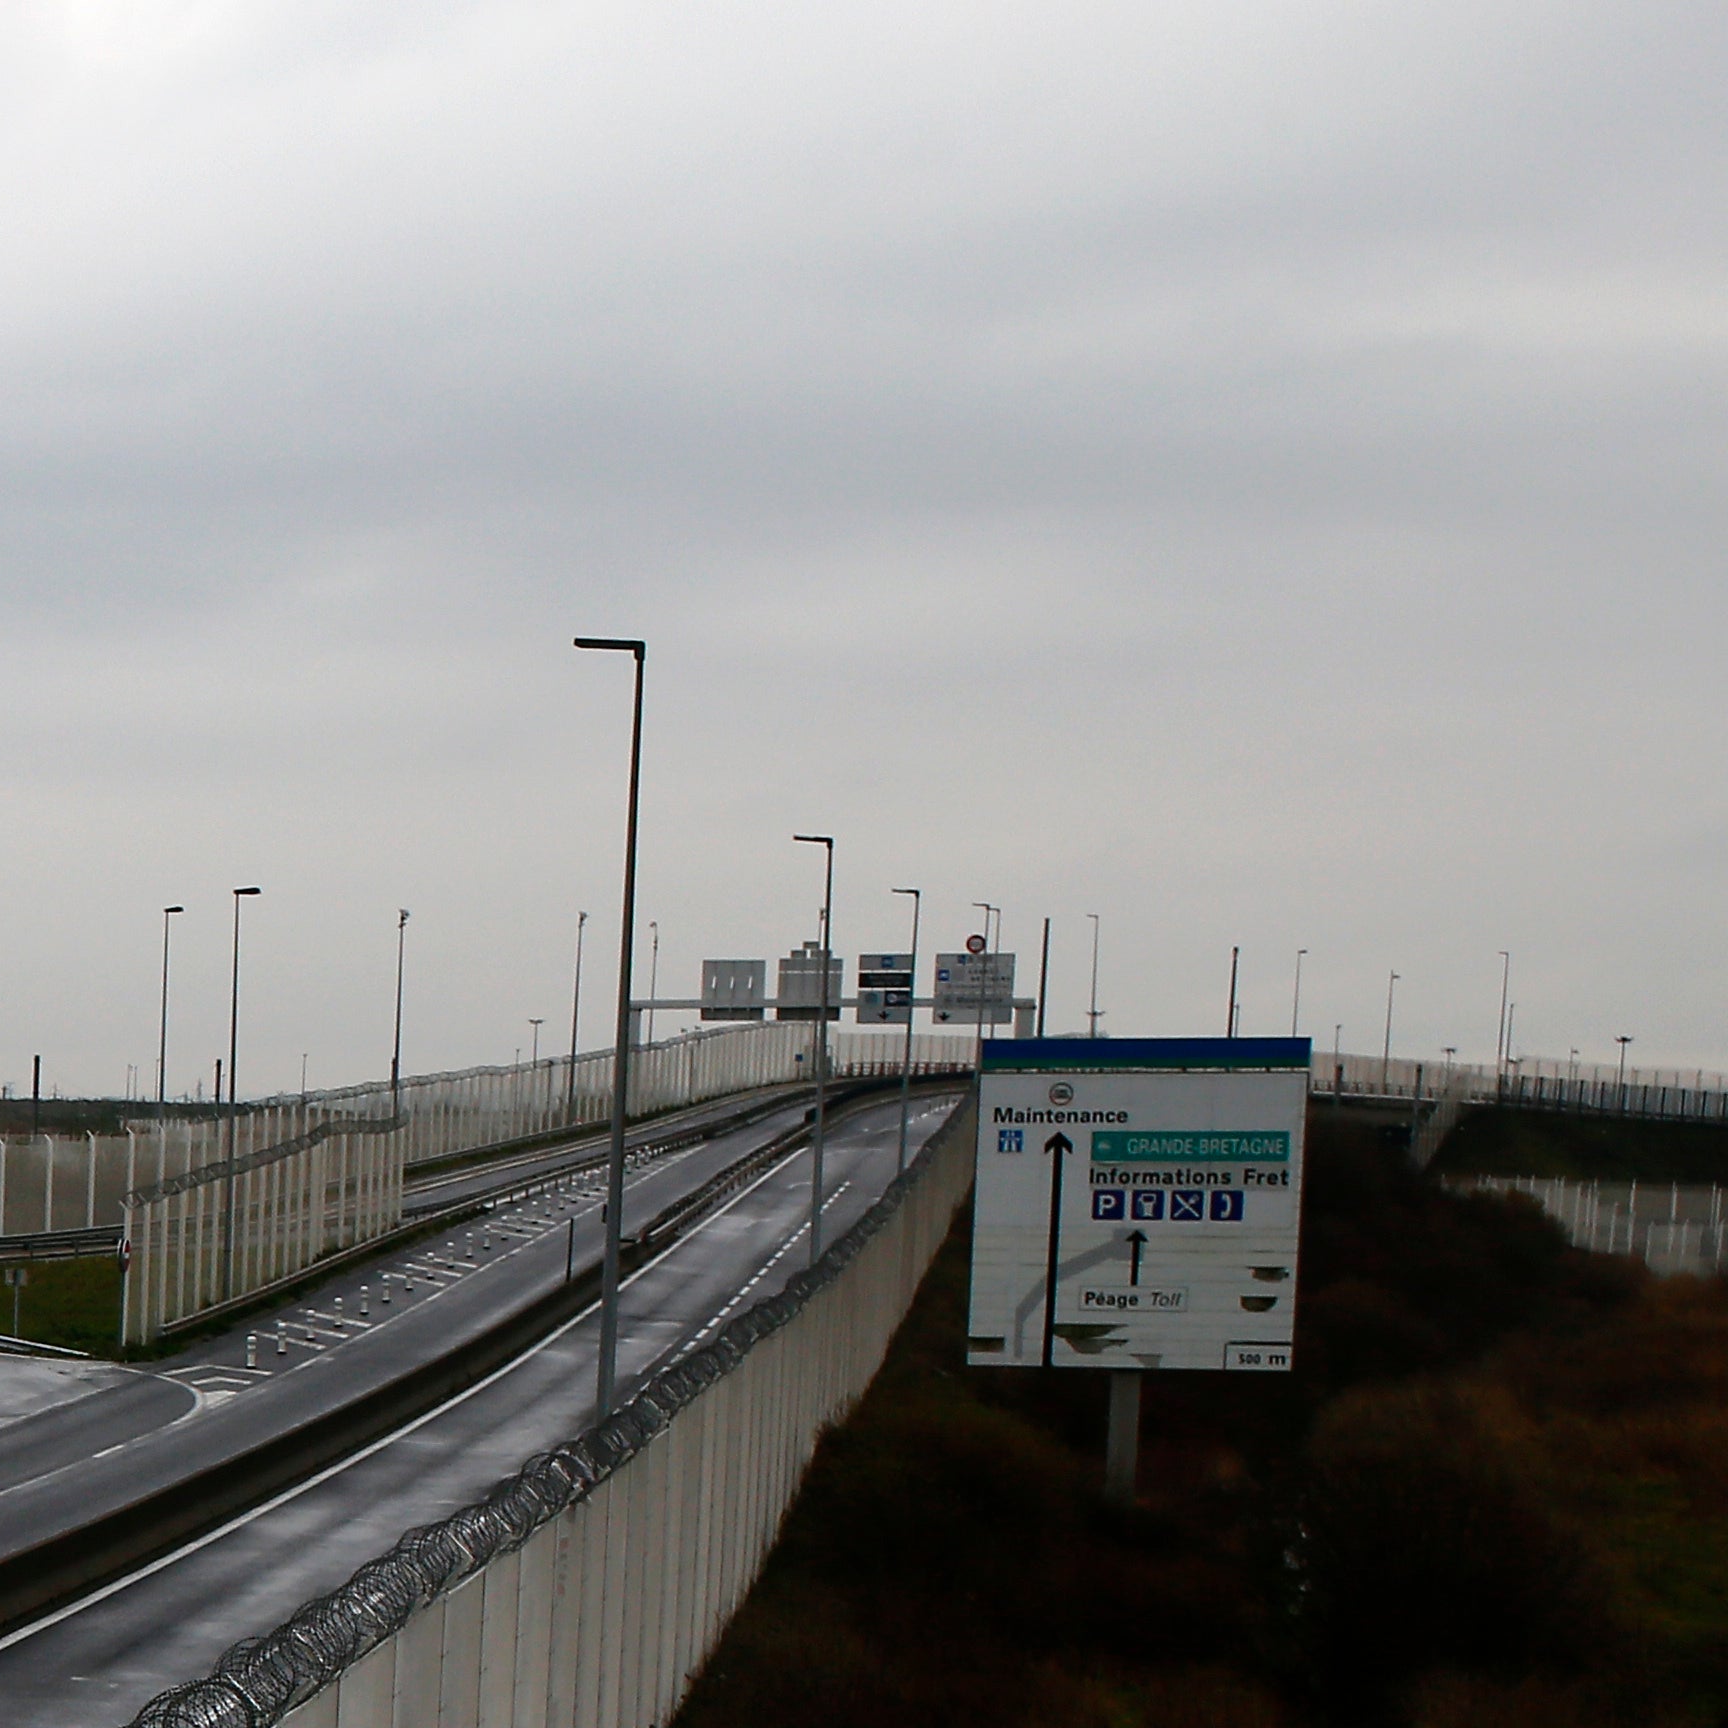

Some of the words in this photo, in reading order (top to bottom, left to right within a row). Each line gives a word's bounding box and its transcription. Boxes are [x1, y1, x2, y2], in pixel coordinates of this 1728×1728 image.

[993, 1107, 1128, 1124] Maintenance
[1089, 1168, 1232, 1186] Informations
[1243, 1168, 1289, 1186] Fret
[1084, 1290, 1139, 1309] Péage
[1151, 1292, 1182, 1306] Toll
[1238, 1353, 1261, 1365] 500
[1268, 1354, 1287, 1365] m
